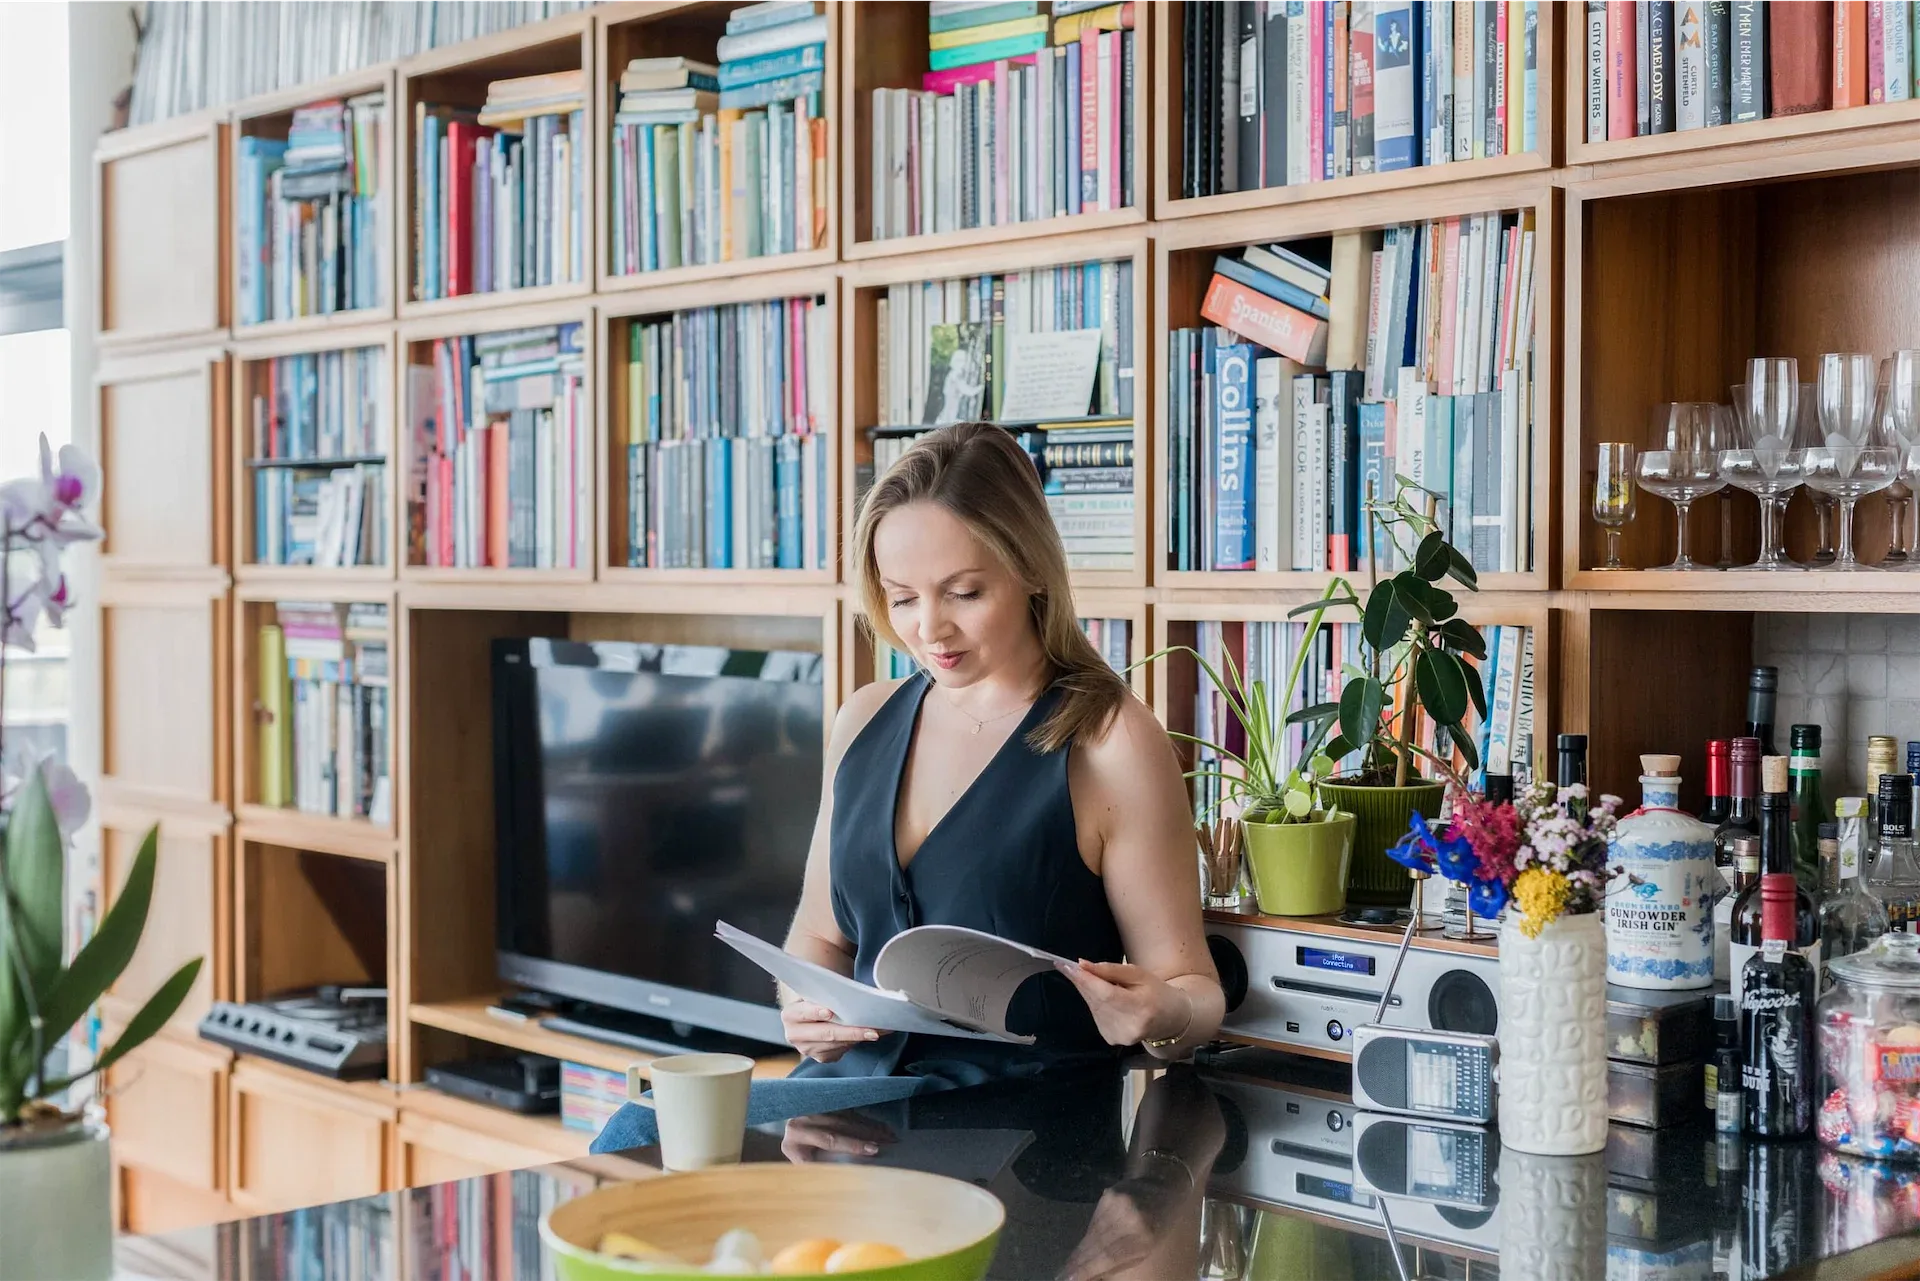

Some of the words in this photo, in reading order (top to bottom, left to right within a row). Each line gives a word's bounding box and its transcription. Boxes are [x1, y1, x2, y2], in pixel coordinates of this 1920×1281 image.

[1592, 22, 1601, 48] CITY
[1739, 14, 1752, 36] MEN
[1836, 26, 1844, 48] Living
[1740, 40, 1752, 64] EMER
[1885, 28, 1894, 51] bible
[1894, 18, 1904, 64] YOUNGER
[1593, 50, 1601, 64] OF
[1836, 50, 1844, 88] Handbook
[1653, 44, 1662, 101] MELODY
[1740, 67, 1752, 104] MARTIN
[1592, 67, 1601, 118] WRITERS
[1373, 254, 1382, 284] NOAM
[1231, 293, 1292, 337] Spanish
[1371, 286, 1381, 335] CHOMSKY
[1415, 395, 1423, 416] NOT
[1220, 356, 1251, 492] Collins
[1298, 412, 1308, 474] FACTOR
[1414, 450, 1422, 478] KIND
[1519, 652, 1533, 715] FASHION
[1882, 824, 1905, 832] BOLS
[1610, 908, 1686, 922] GUNPOWDER
[1614, 901, 1680, 910] DRUMSHANBO
[1617, 919, 1648, 930] IRISH
[1653, 922, 1676, 932] GIN
[1322, 958, 1354, 969] Connecting
[1332, 953, 1345, 962] iPod
[1741, 990, 1800, 1016] Niepoort
